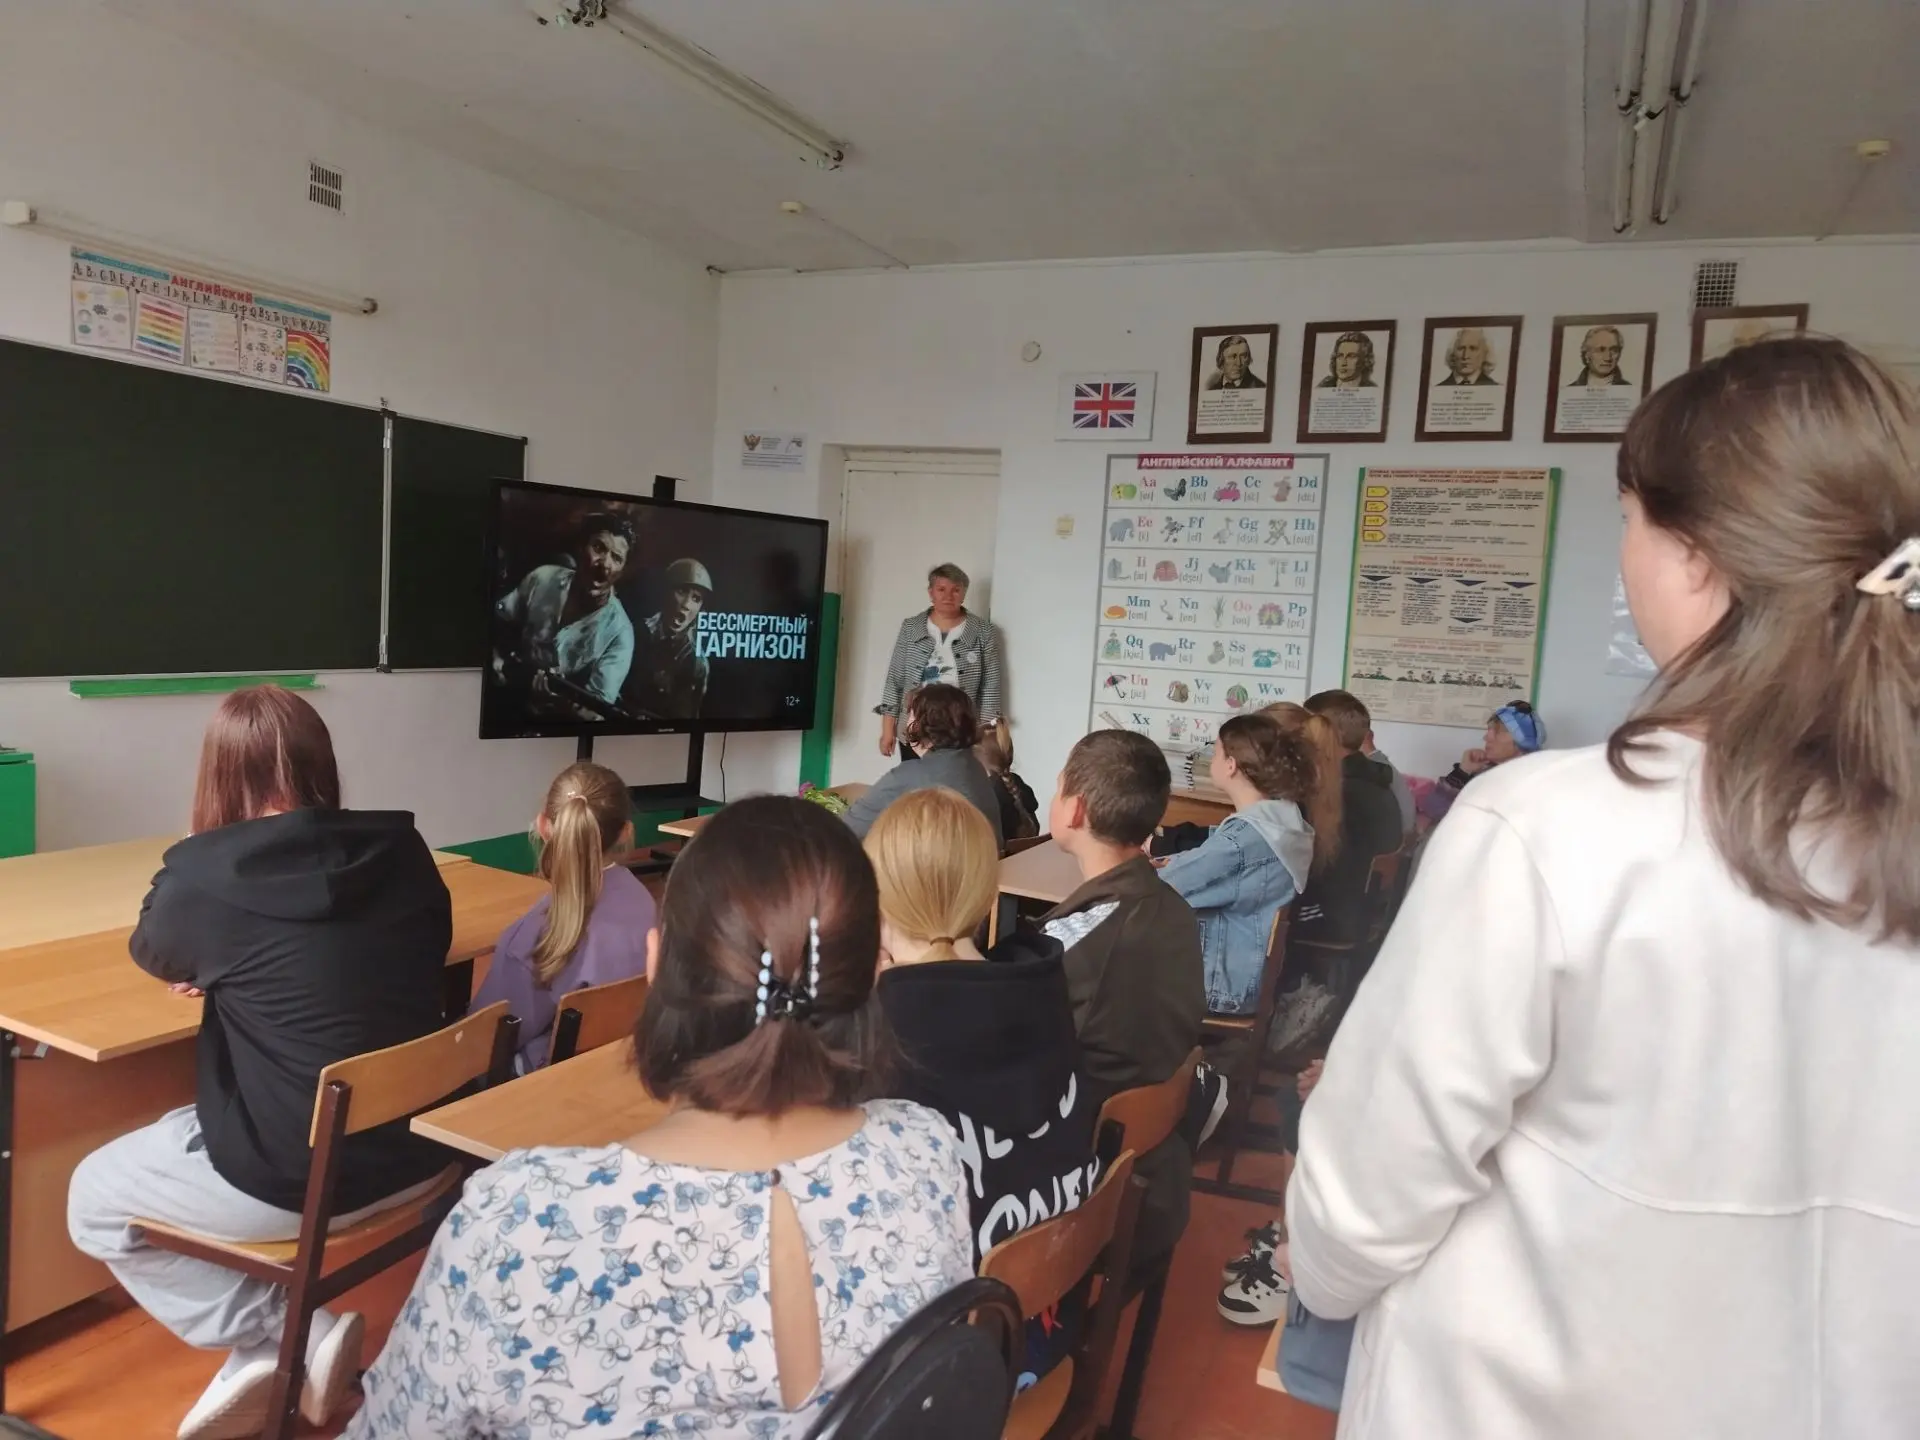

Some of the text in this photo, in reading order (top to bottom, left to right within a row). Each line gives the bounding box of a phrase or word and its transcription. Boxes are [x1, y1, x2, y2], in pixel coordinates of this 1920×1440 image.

[1141, 455, 1290, 468] АНГЛИЙСКИЙ АЛФАВИТ
[1190, 475, 1209, 488] Bb
[1244, 475, 1261, 488] Cc
[1298, 476, 1318, 489] Dd
[1138, 516, 1315, 532] Ee Ff Gg Hh
[1184, 557, 1199, 572] Jj
[1235, 559, 1256, 571] Kk
[1127, 595, 1307, 617] Mm Nn Oo Pp
[697, 612, 808, 634] БЕССМЕРТНЫЙ
[695, 631, 806, 660] ГАРНИЗОН
[1126, 634, 1301, 656] Qq Rr Ss Tt
[1131, 674, 1285, 696] Uu Vv Ww
[785, 696, 800, 706] 12+
[1132, 713, 1211, 732] Xx Yy
